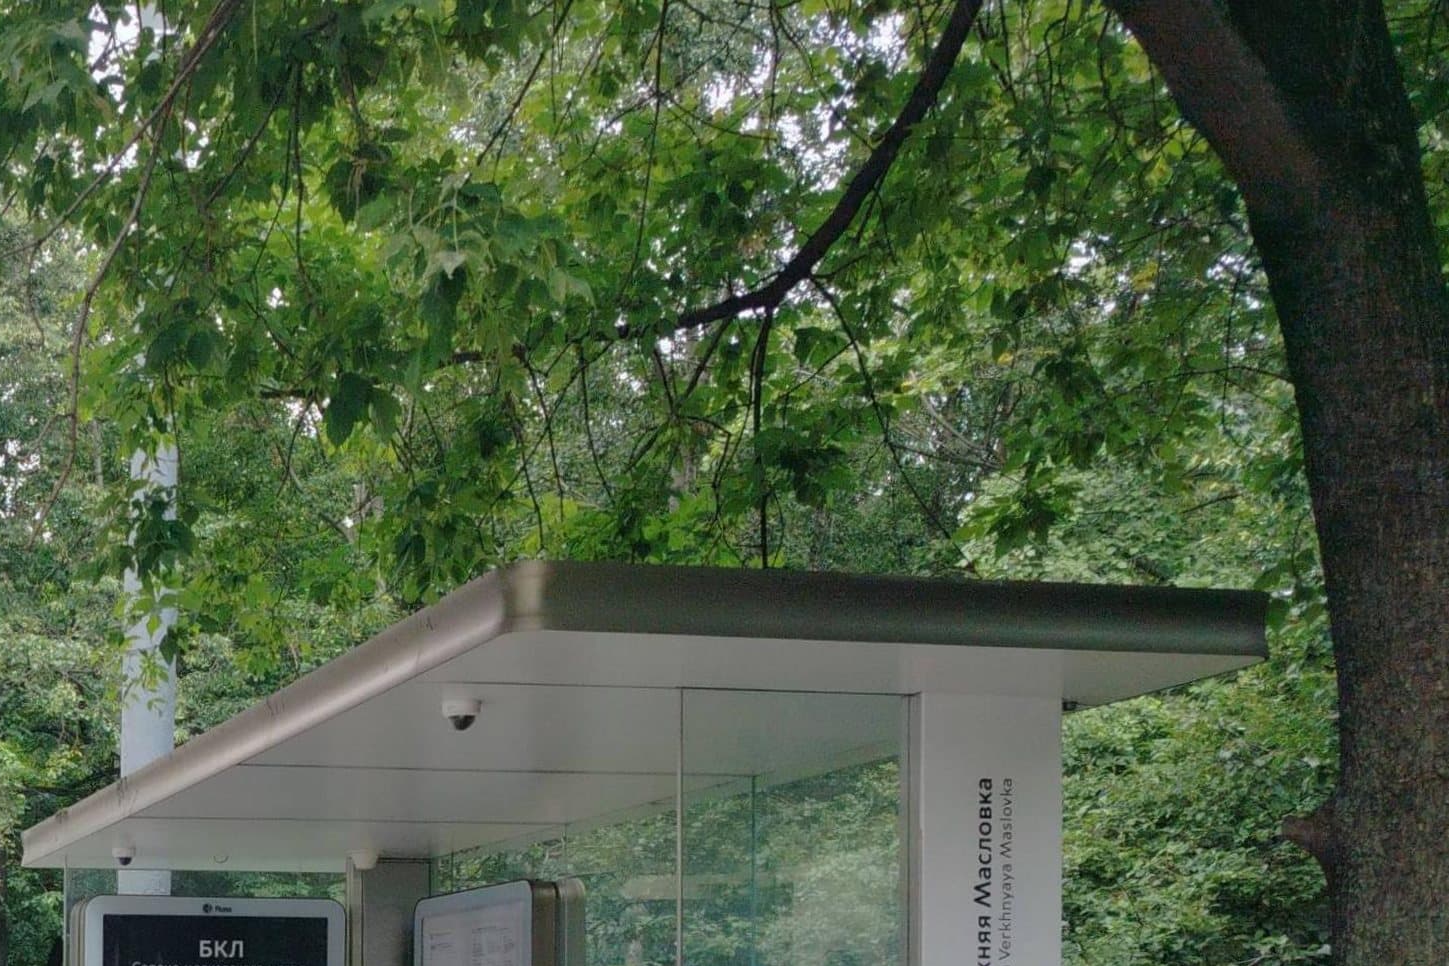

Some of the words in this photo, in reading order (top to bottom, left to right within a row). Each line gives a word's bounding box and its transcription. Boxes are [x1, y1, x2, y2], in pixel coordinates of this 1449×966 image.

[973, 777, 994, 908] Масловка
[999, 777, 1013, 858] Maslovka
[199, 940, 244, 958] БКЛ
[998, 863, 1015, 961] Verkhnyaya
